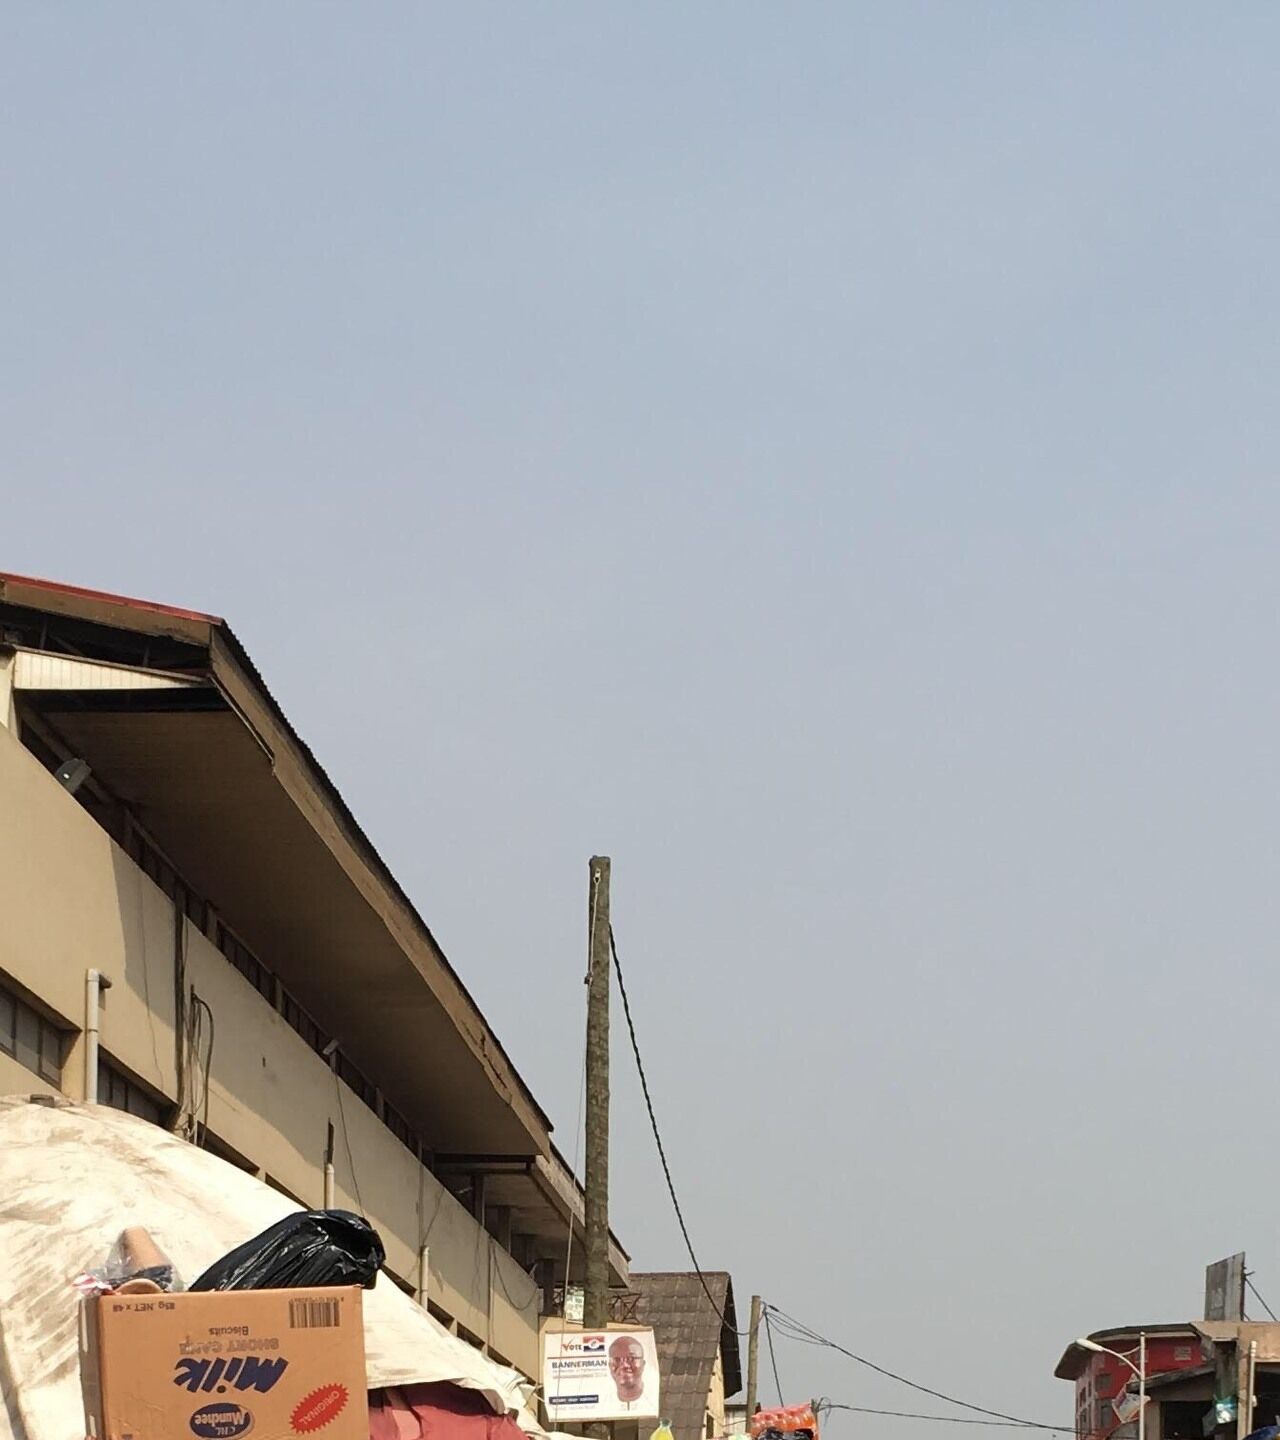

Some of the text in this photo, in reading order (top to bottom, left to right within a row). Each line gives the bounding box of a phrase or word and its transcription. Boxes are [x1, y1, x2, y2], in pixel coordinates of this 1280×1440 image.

[208, 1326, 249, 1336] Biscuits
[552, 1360, 608, 1369] BANNERMAN
[173, 1356, 289, 1394] Milk
[300, 1390, 341, 1426] ORIGINAL
[194, 1410, 248, 1427] Munchee
